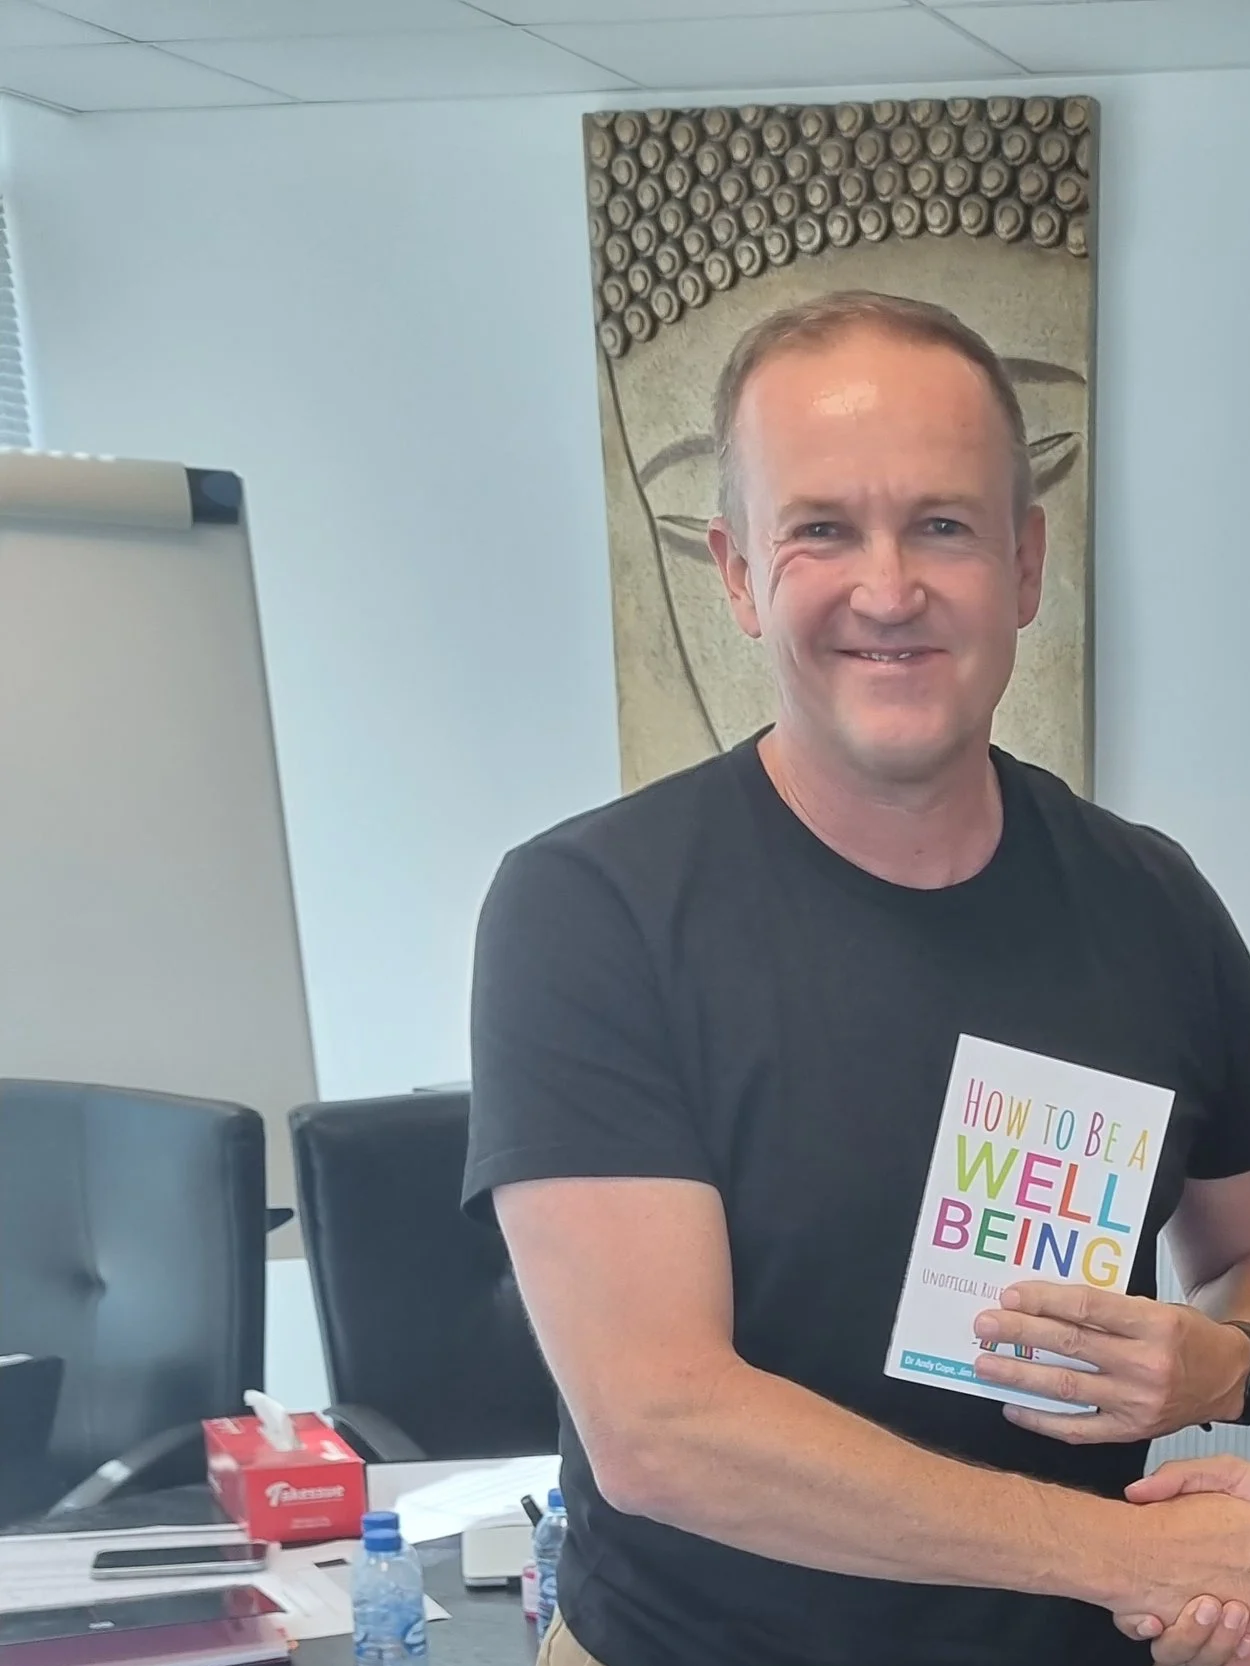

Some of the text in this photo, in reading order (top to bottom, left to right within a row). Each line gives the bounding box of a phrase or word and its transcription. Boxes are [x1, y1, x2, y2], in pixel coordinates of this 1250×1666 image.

[963, 1078, 1148, 1171] HOW TO BE A
[957, 1134, 1131, 1234] WELL
[922, 1268, 978, 1296] UNOFFICIAL
[932, 1197, 1122, 1288] BEING
[904, 1355, 915, 1365] Dr
[915, 1358, 934, 1371] Andy
[935, 1362, 956, 1375] Cope,
